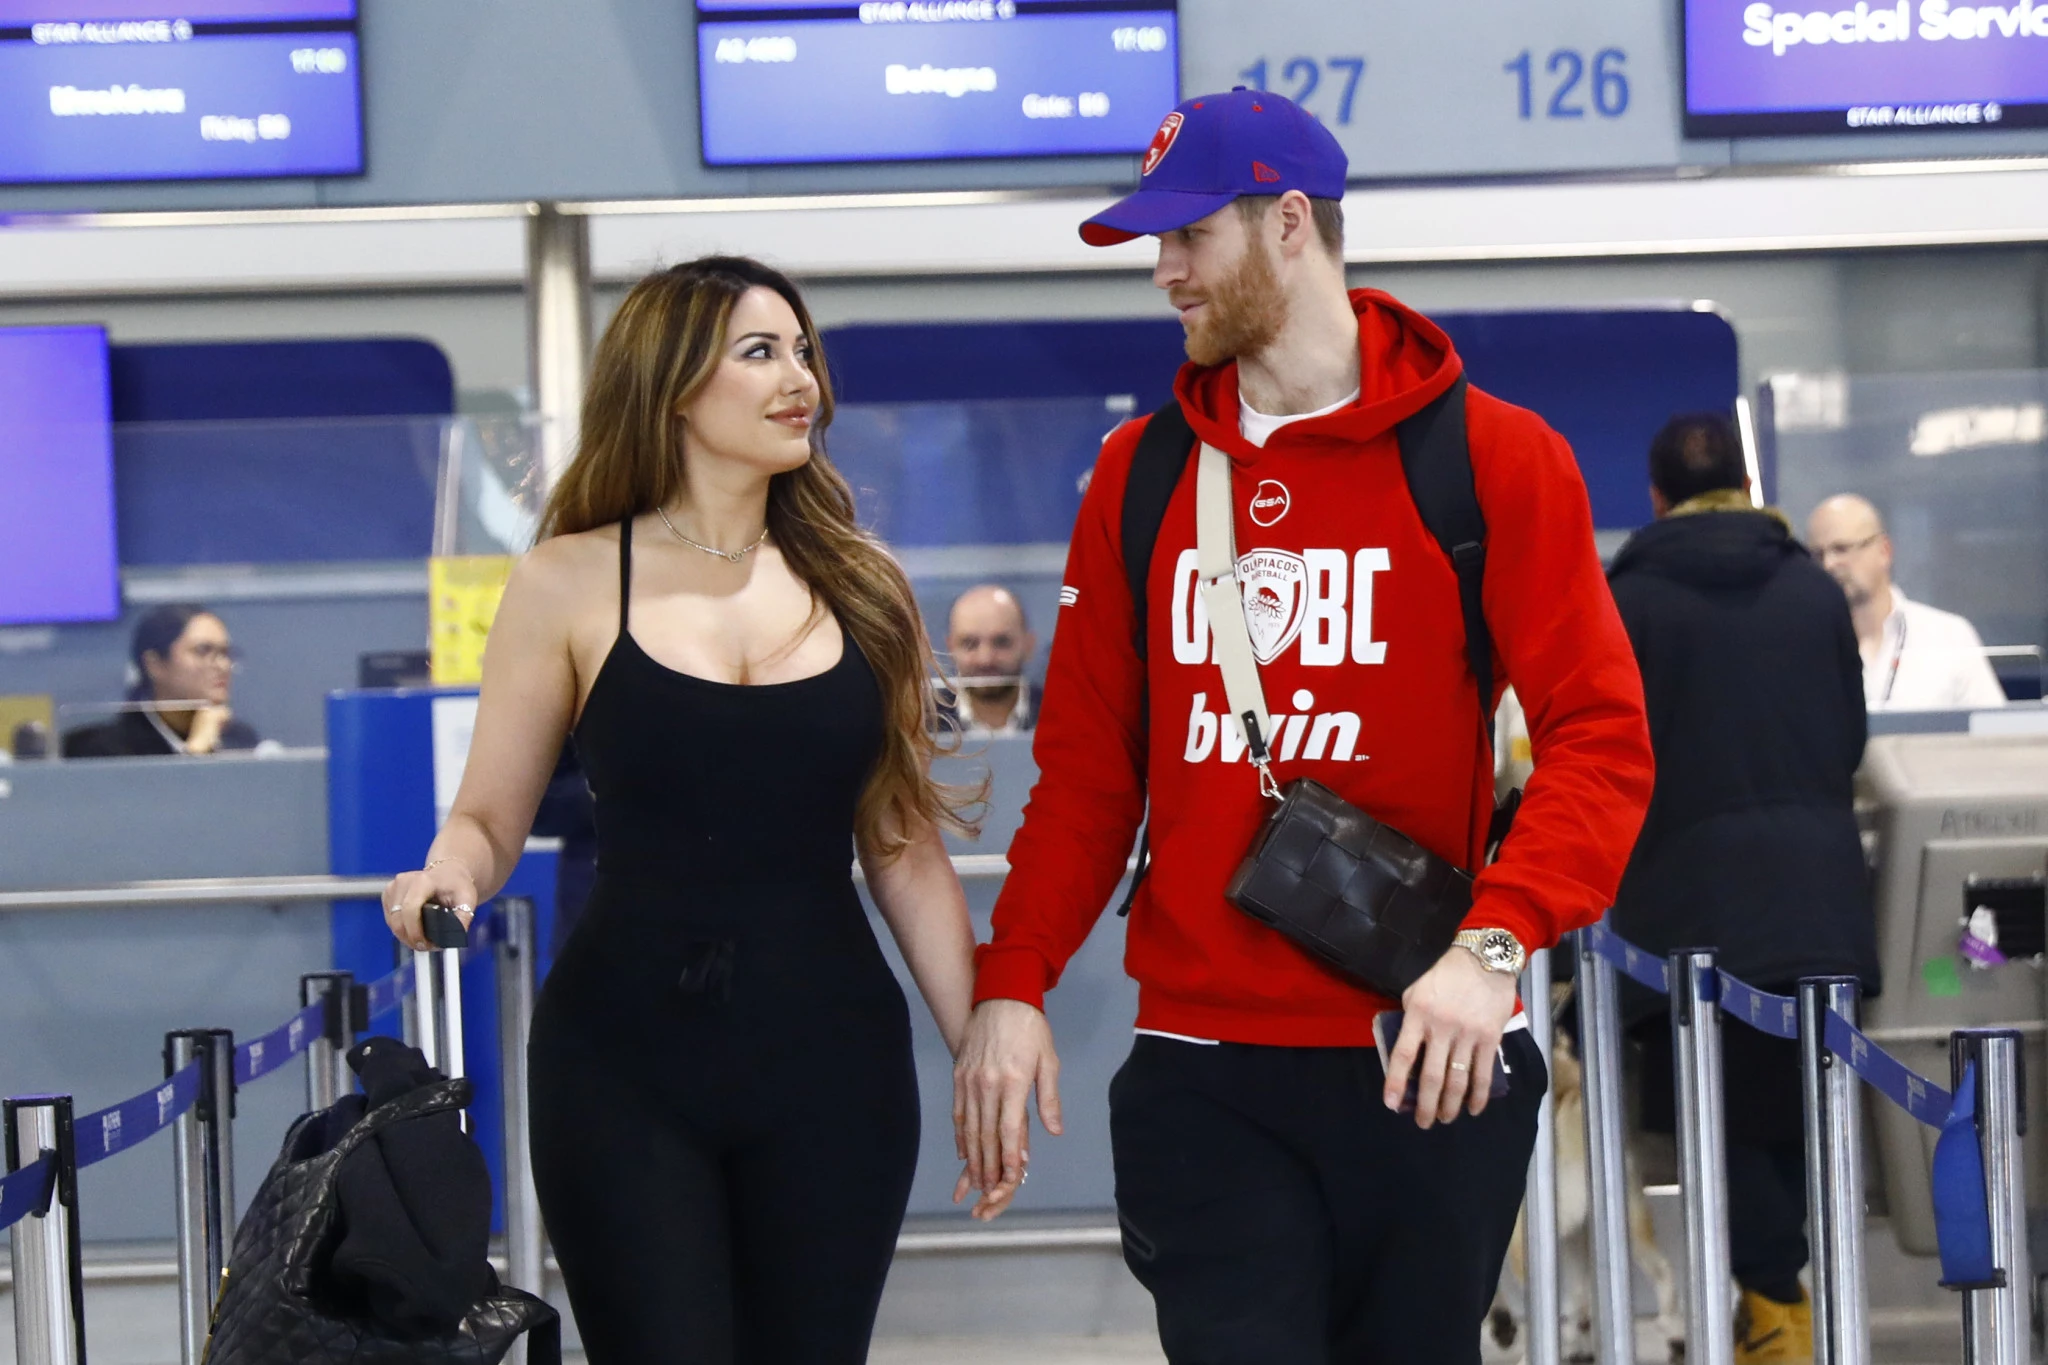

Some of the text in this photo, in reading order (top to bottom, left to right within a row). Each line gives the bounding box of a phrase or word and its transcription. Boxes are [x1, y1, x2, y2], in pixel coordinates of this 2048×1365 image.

[1743, 0, 1910, 56] Special
[1503, 47, 1631, 120] 126
[1255, 496, 1285, 508] GSA
[1171, 548, 1391, 667] OBC
